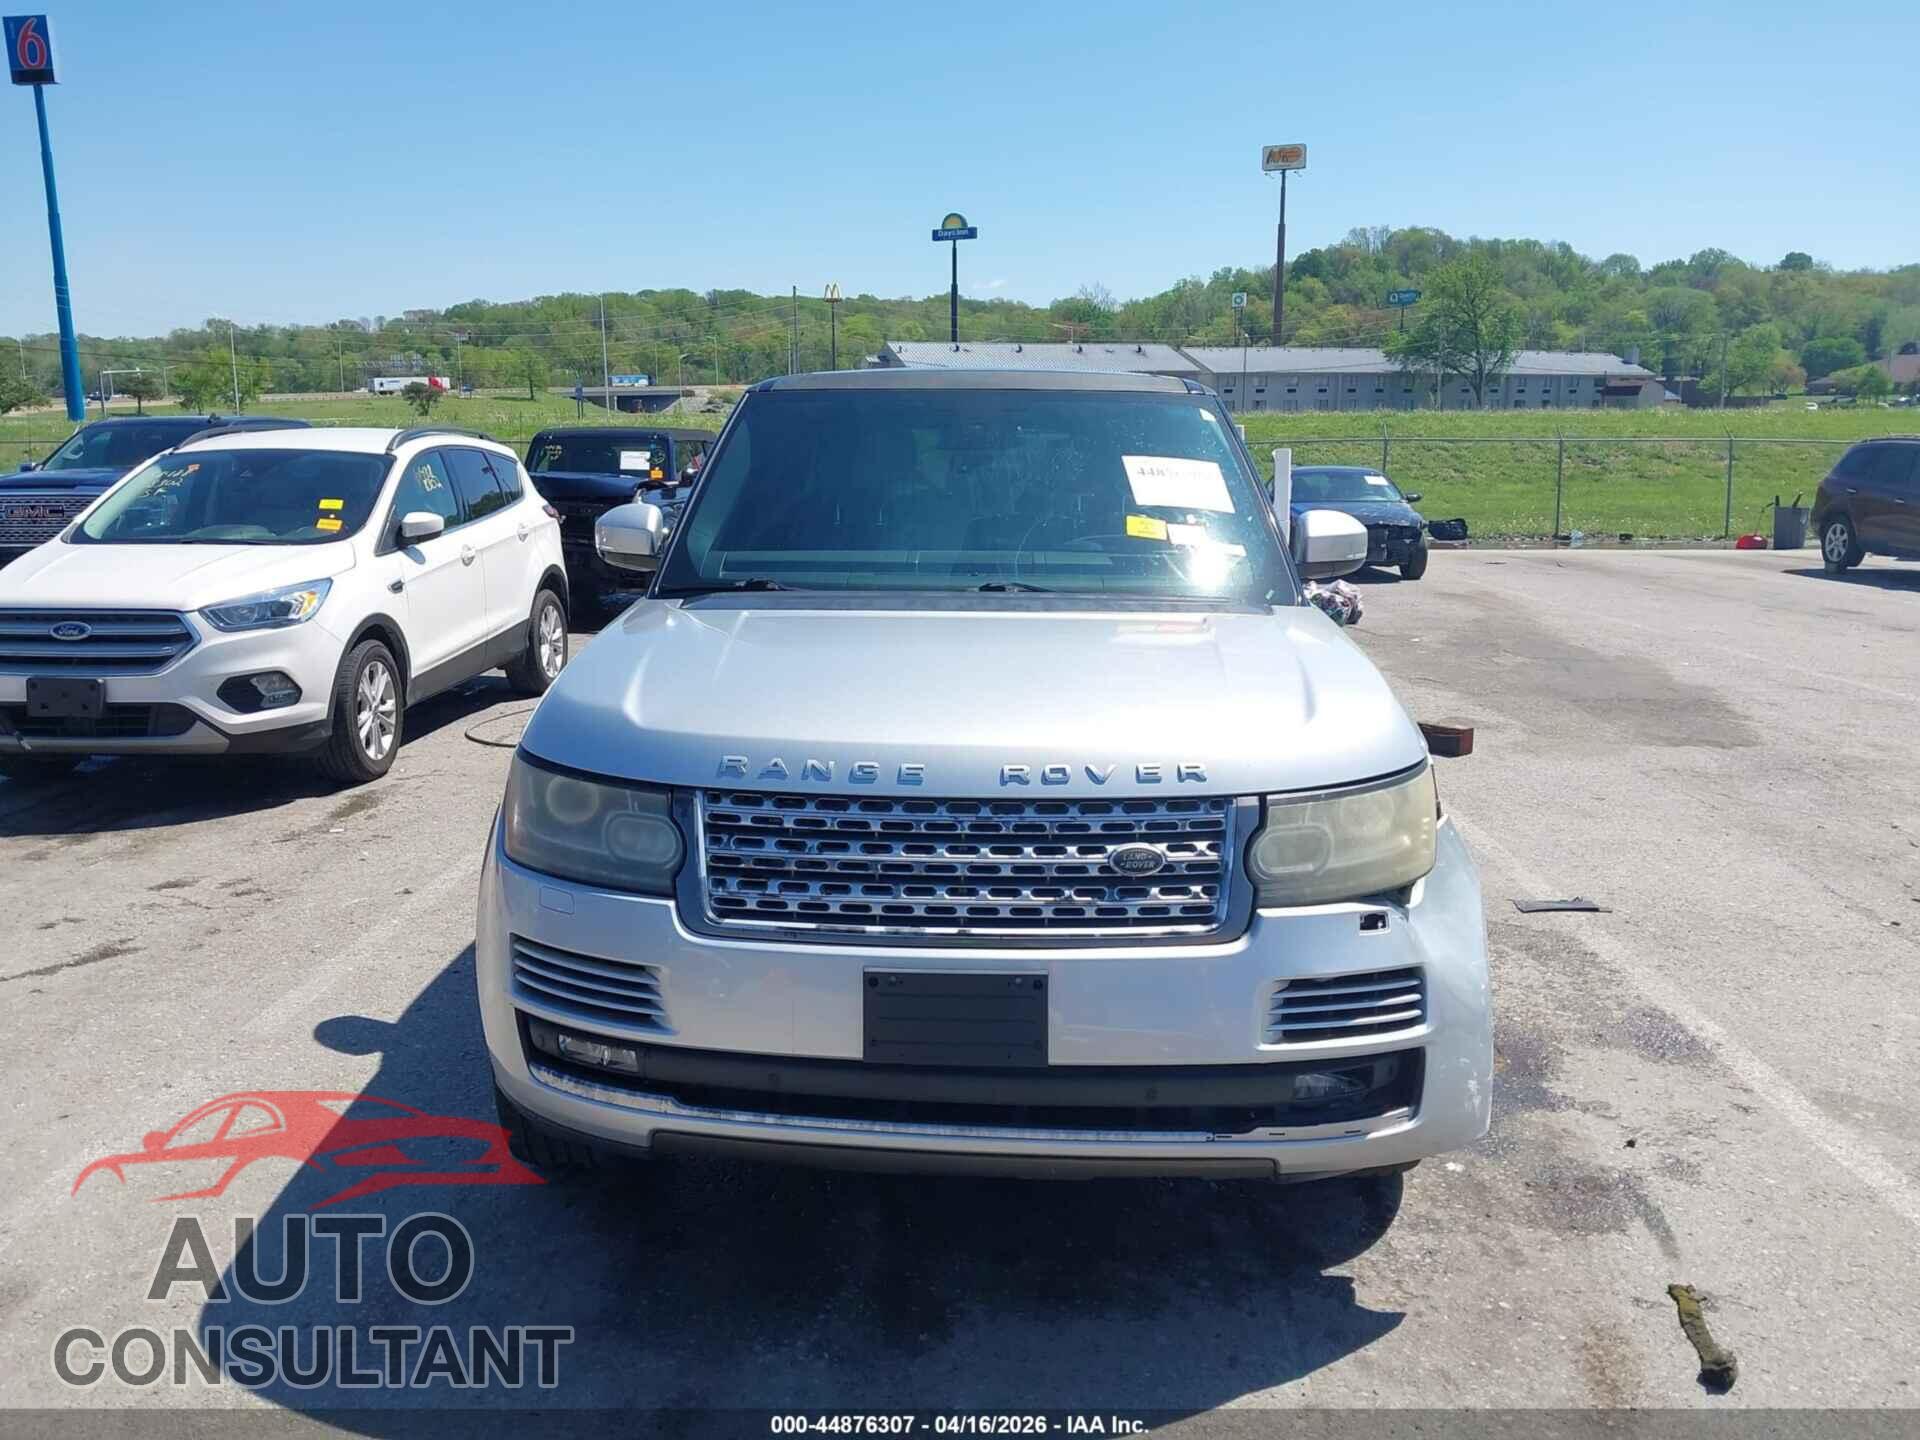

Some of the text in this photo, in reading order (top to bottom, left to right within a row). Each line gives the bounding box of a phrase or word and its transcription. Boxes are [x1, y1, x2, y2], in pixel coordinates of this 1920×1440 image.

[17, 17, 47, 69] 6
[7, 505, 63, 518] GMC
[716, 755, 1208, 786] RANGE ROVER
